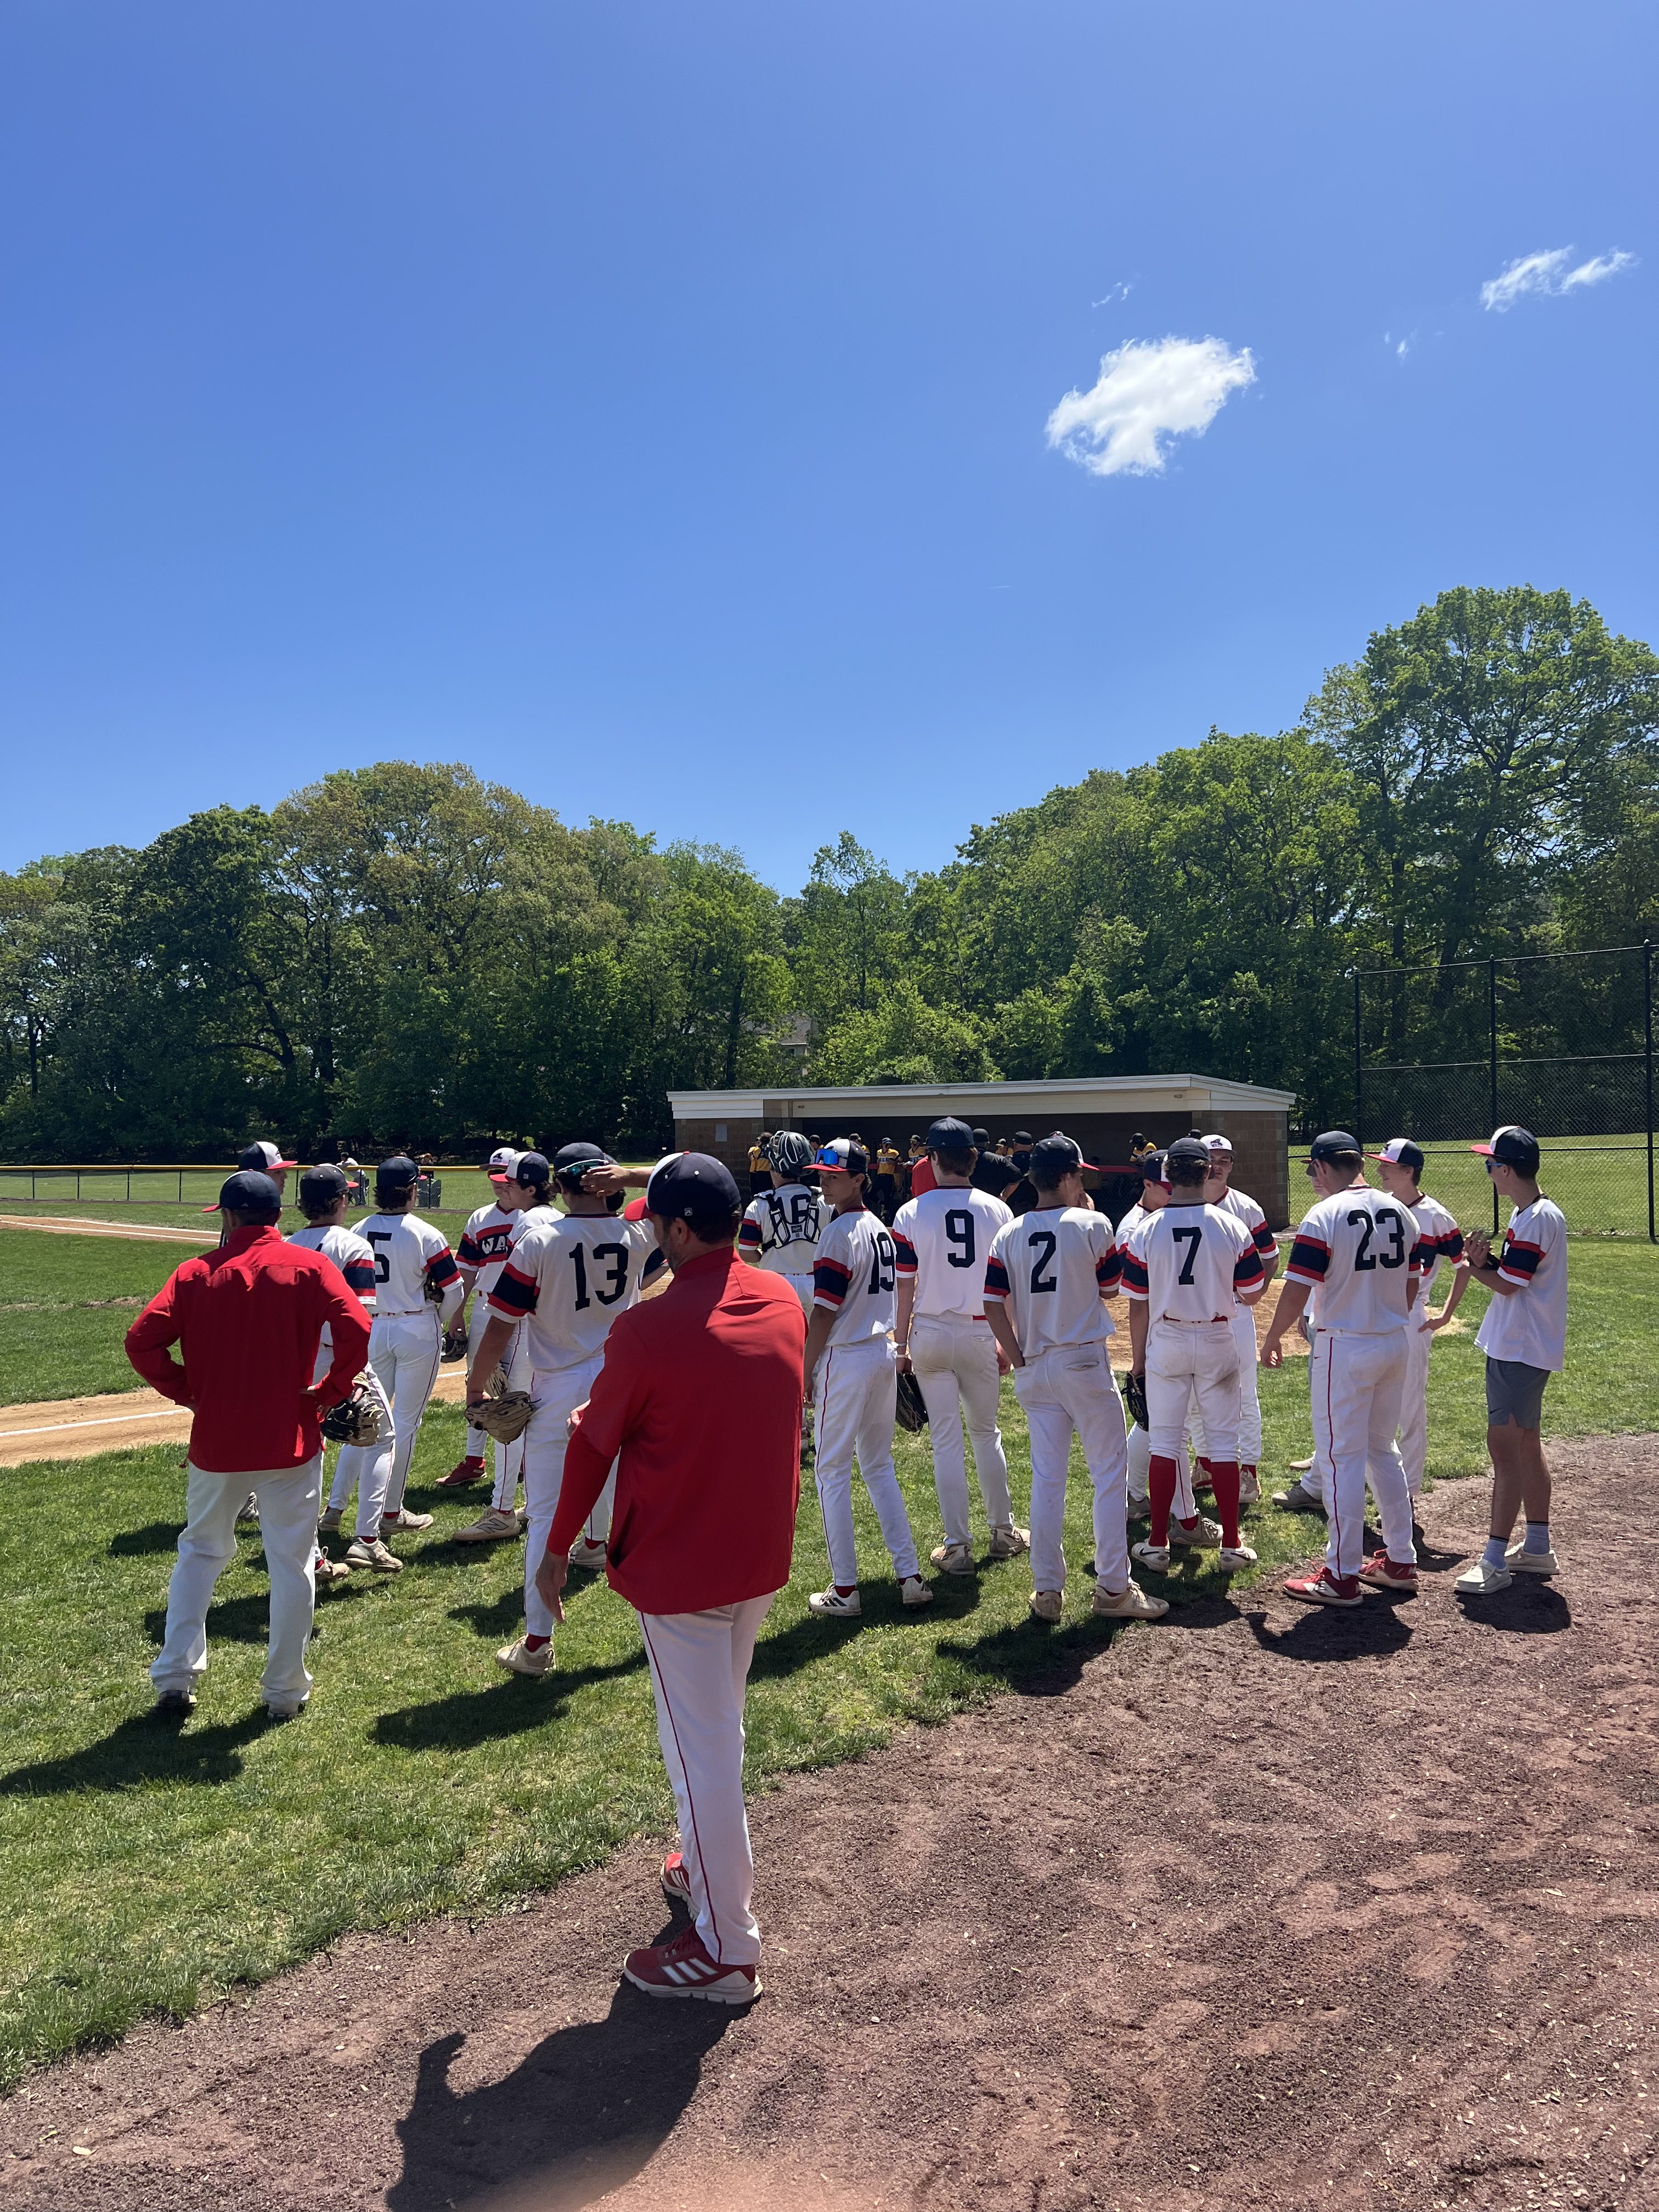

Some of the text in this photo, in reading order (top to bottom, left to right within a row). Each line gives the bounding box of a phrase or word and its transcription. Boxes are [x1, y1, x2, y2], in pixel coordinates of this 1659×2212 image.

[367, 1231, 392, 1283] 5
[482, 1235, 508, 1254] WA
[868, 1232, 895, 1294] 19
[945, 1209, 975, 1268] 9
[1028, 1231, 1057, 1293] 2
[1172, 1227, 1202, 1285] 7
[1347, 1208, 1405, 1271] 23
[569, 1243, 629, 1312] 13
